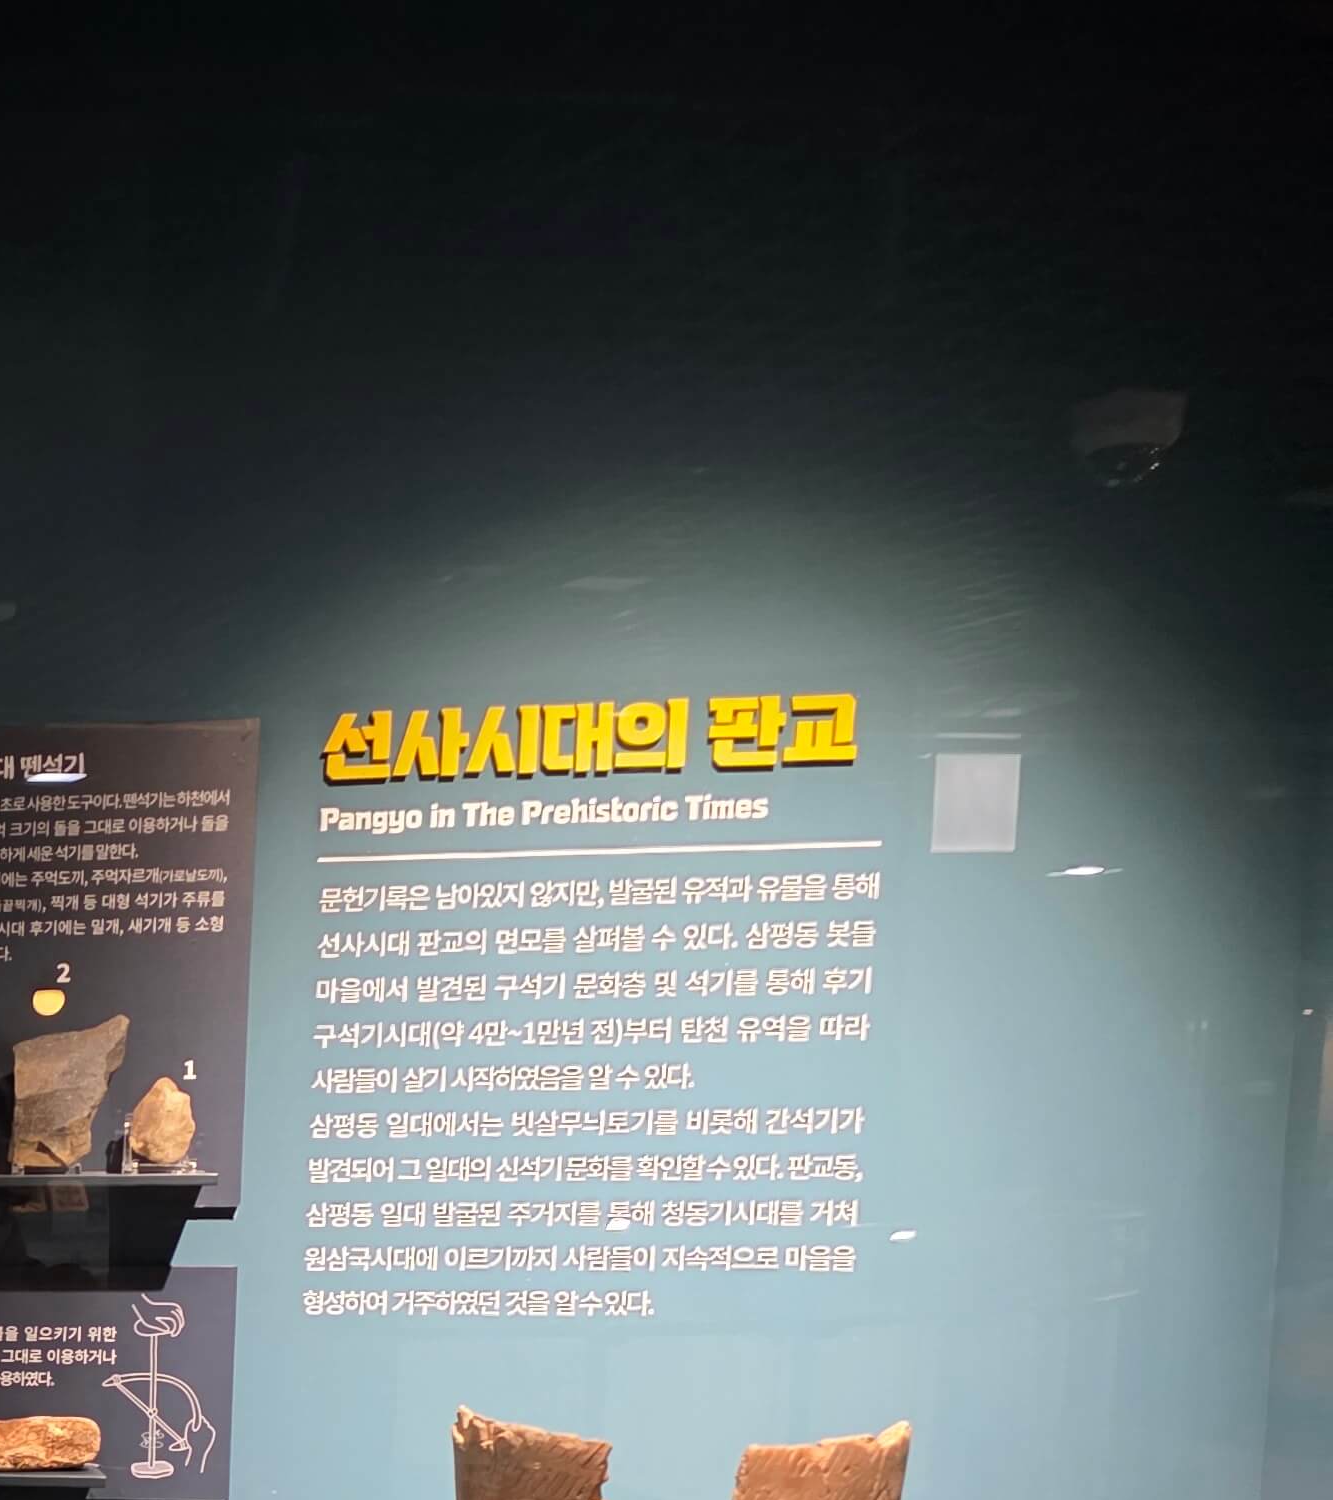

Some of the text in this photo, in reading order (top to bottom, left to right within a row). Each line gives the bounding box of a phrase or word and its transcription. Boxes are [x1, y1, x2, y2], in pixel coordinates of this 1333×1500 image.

[321, 694, 858, 780] 선사시대의 판교
[321, 794, 768, 834] Pangyo in The Prehistoric Times
[320, 872, 880, 912] 문헌기록은 남아있지 않지만, 발굴된 유적과 유물을 통해
[318, 920, 876, 958] 선사시대 판교의 면모를 살펴볼 수 있다. 삼평동 봇들
[57, 964, 70, 982] 2
[184, 1060, 196, 1080] 1
[25, 1326, 81, 1342] 일으키기
[88, 1327, 117, 1342] 위한
[1, 1349, 42, 1364] 그대로
[47, 1349, 117, 1364] 이용하거나
